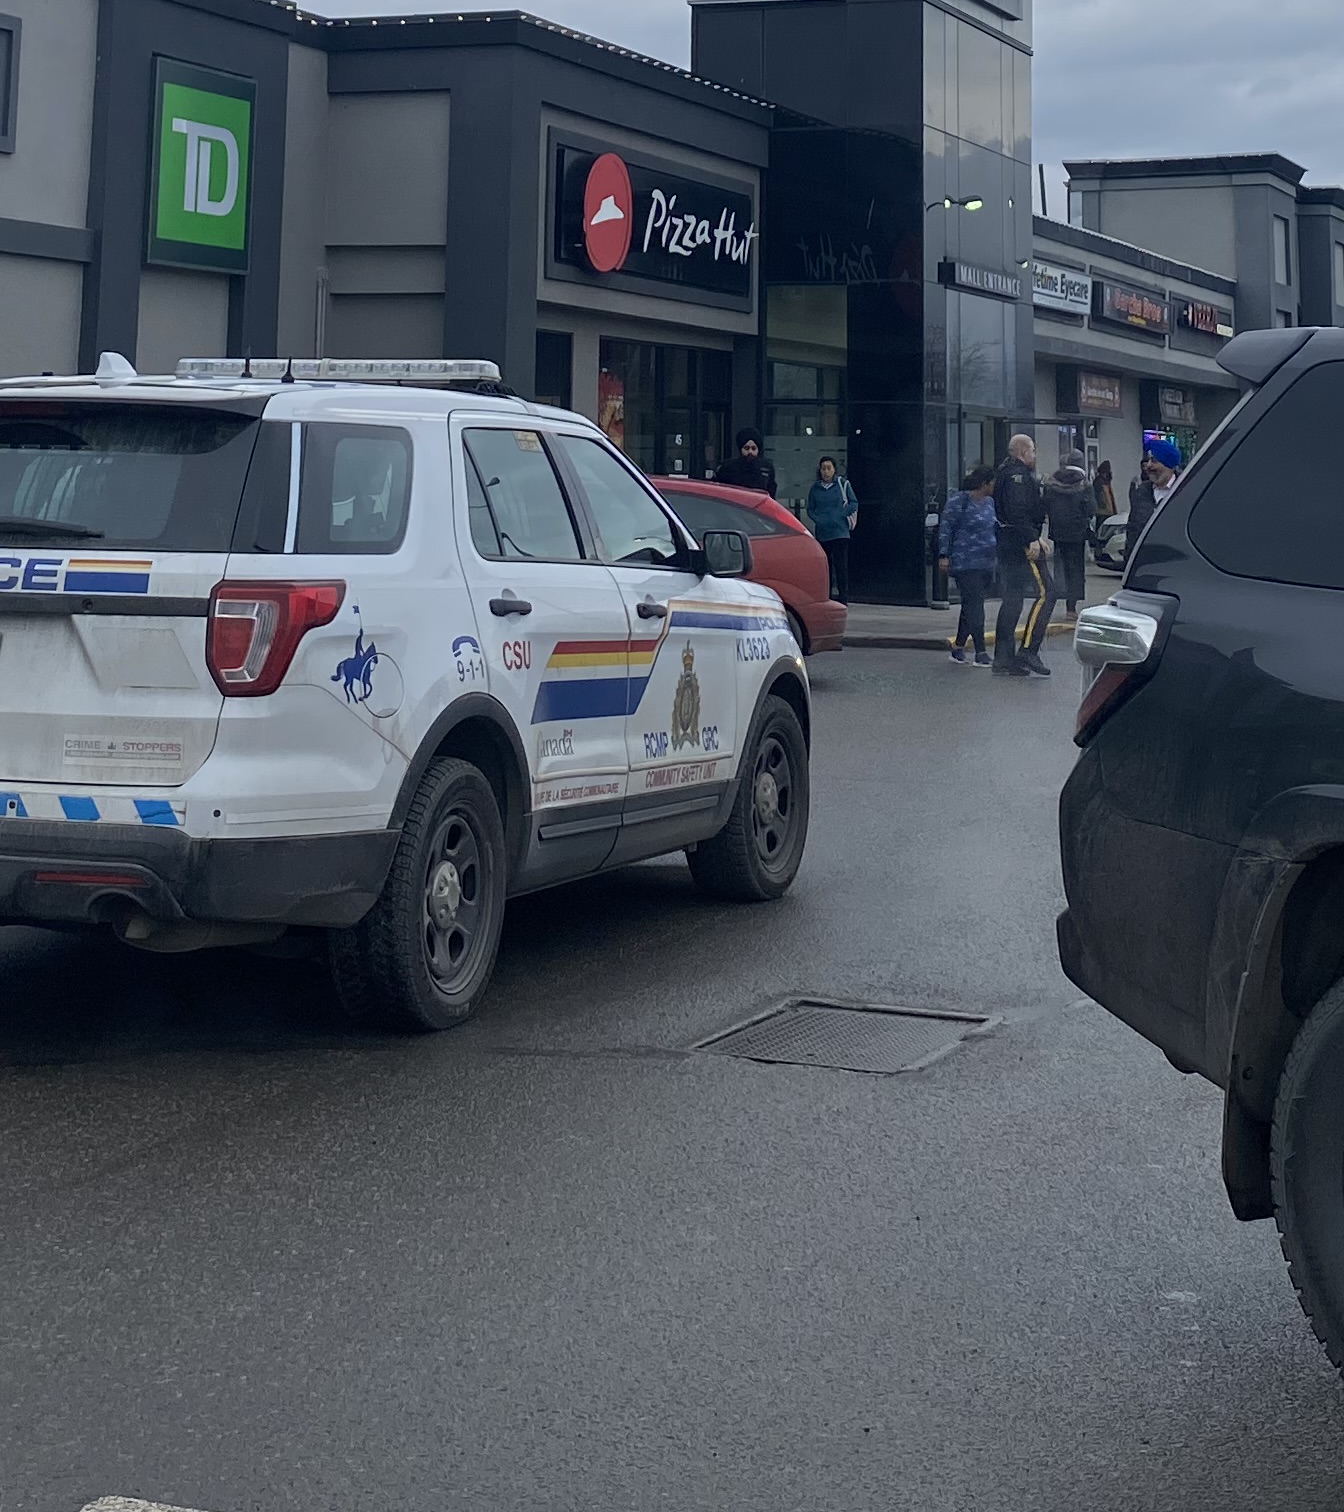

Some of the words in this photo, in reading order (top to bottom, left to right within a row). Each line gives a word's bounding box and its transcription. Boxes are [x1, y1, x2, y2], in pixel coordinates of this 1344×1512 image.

[172, 117, 239, 216] TD
[643, 188, 711, 257] Pizza
[713, 207, 759, 265] Hut
[960, 265, 981, 286] MALL
[983, 271, 1021, 297] ENTRANCE
[1060, 273, 1089, 300] Eyecare
[502, 640, 531, 670] CSU
[736, 637, 771, 662] KL3623
[457, 657, 485, 682] 9-1-1
[65, 739, 101, 750] CRIME
[122, 741, 182, 753] STOPPERS
[536, 731, 574, 759] Canada
[644, 731, 669, 759] RCMP
[702, 725, 720, 751] GRC
[645, 767, 682, 788] COMMUNITY
[680, 764, 703, 782] SAFETY
[703, 762, 718, 779] UNIT
